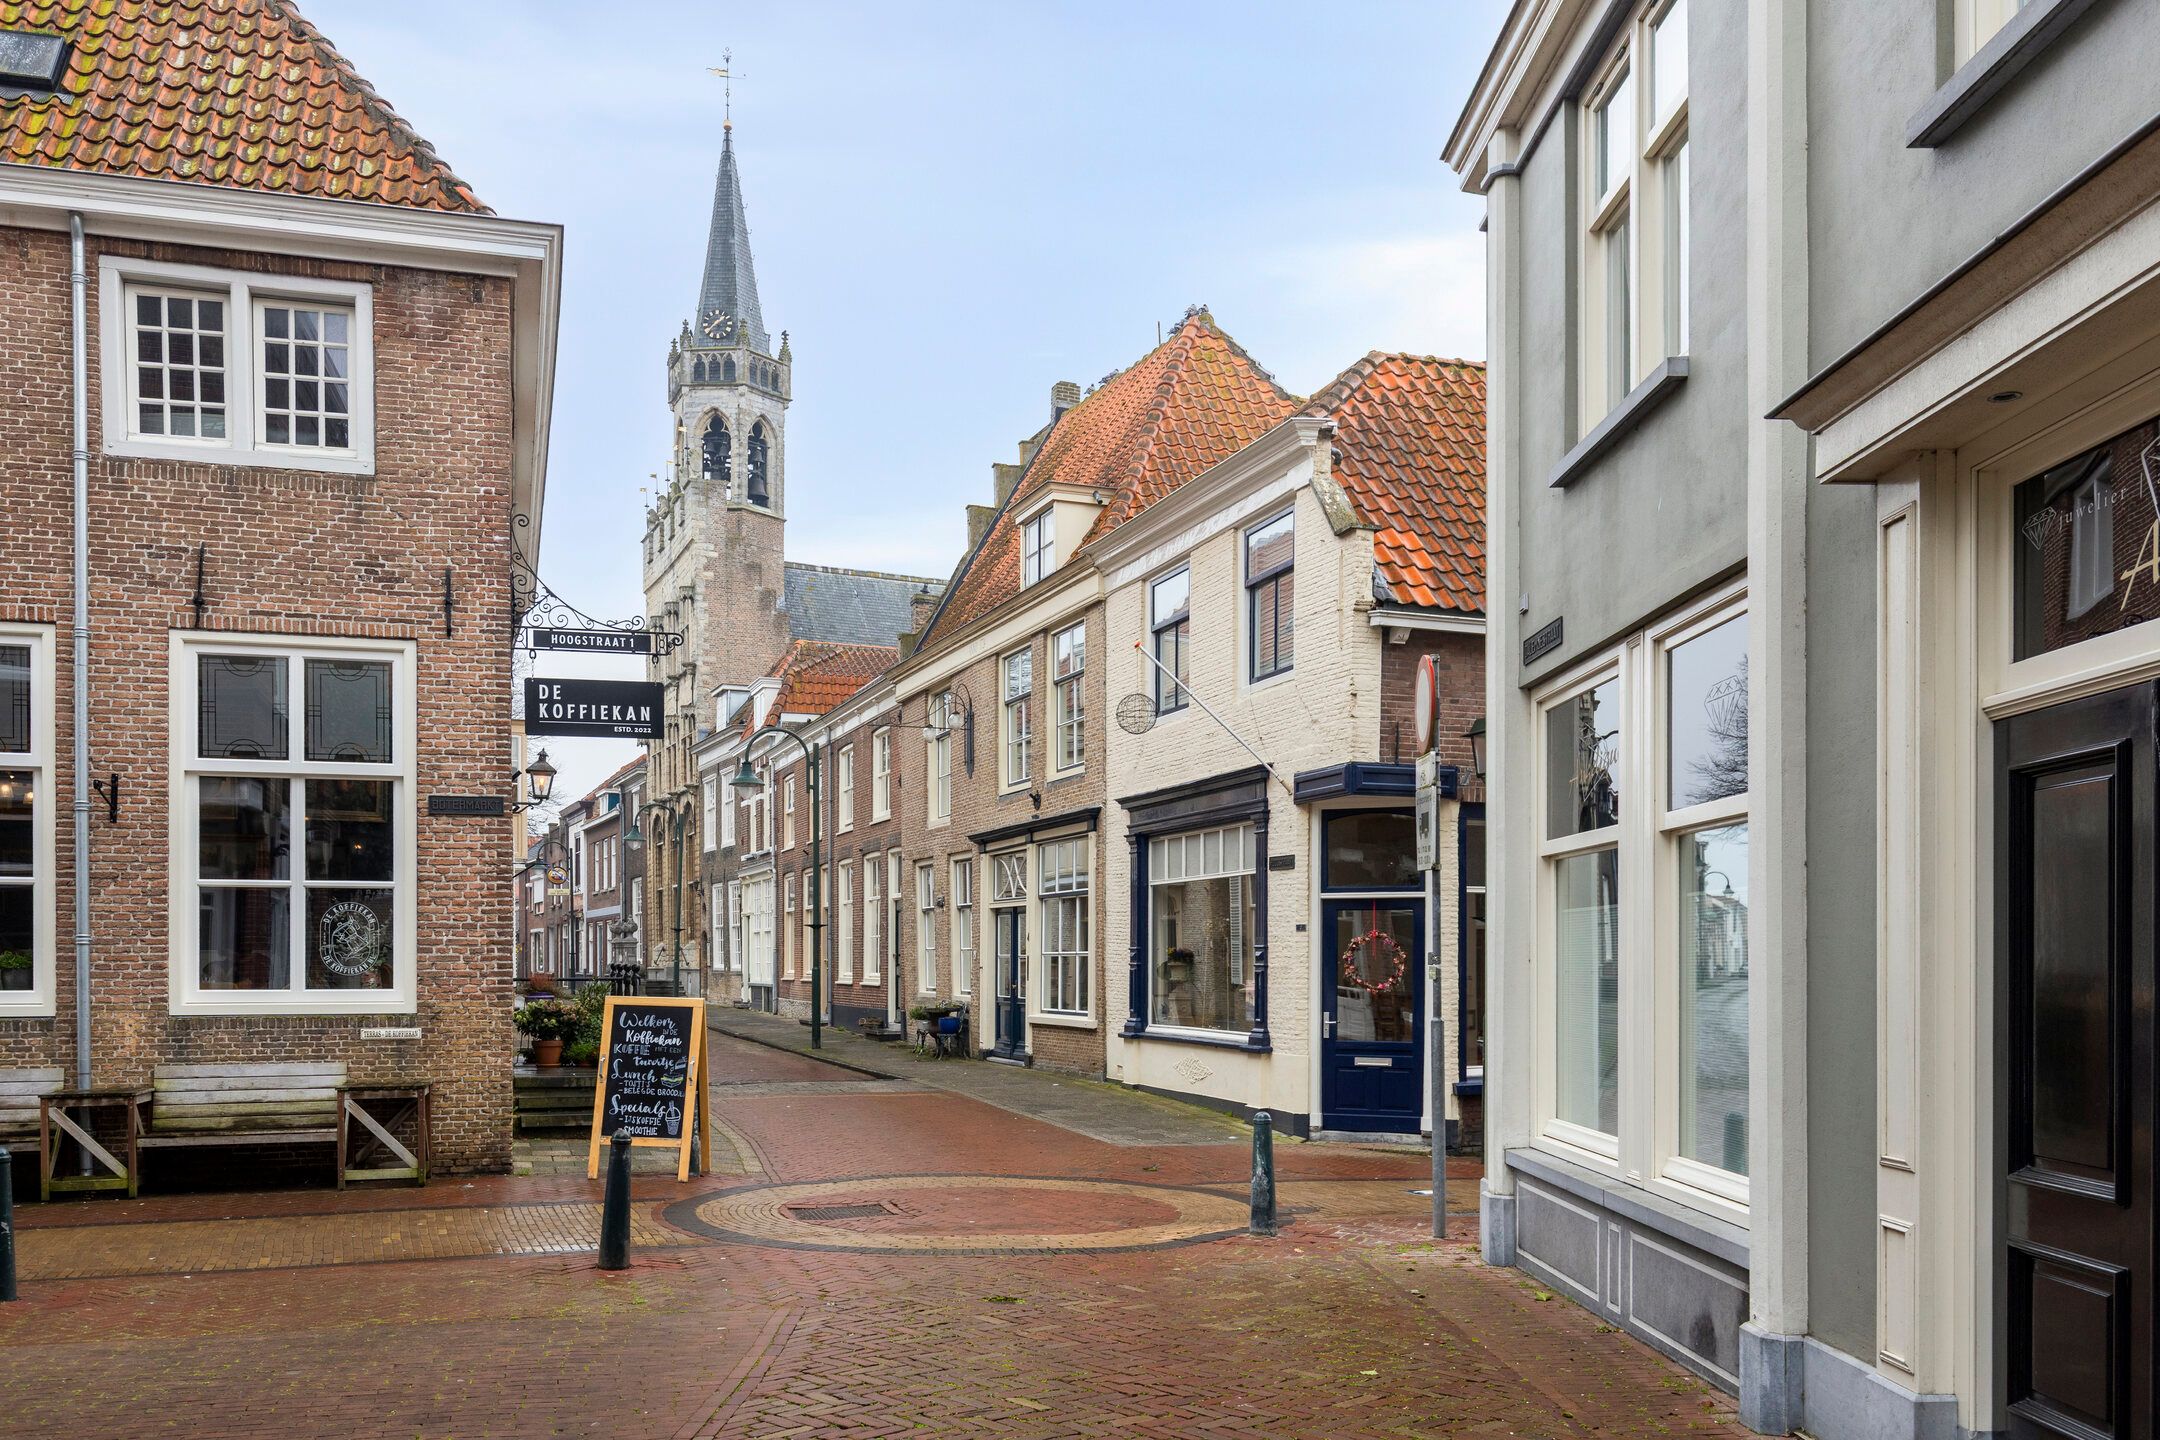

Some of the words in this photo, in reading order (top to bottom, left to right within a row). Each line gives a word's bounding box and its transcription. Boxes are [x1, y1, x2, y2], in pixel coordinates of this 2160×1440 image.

[2059, 488, 2127, 531] juwelier
[551, 634, 627, 648] HOOGSTRAAT
[629, 638, 635, 648] 1
[539, 684, 562, 700] DE
[539, 703, 651, 721] KOFFIEKAN
[431, 799, 501, 811] BOTERMARKT
[323, 913, 333, 924] DE
[332, 903, 376, 924] KOFFIEKAN
[619, 1011, 676, 1030] Welkom
[625, 1029, 682, 1047] Koffiekan
[613, 1043, 651, 1056] KOFFIE
[611, 1058, 658, 1083] Lunch
[623, 1087, 656, 1096] BELEGDE
[609, 1094, 667, 1118] Specials
[623, 1125, 658, 1136] SMOOTHIE
